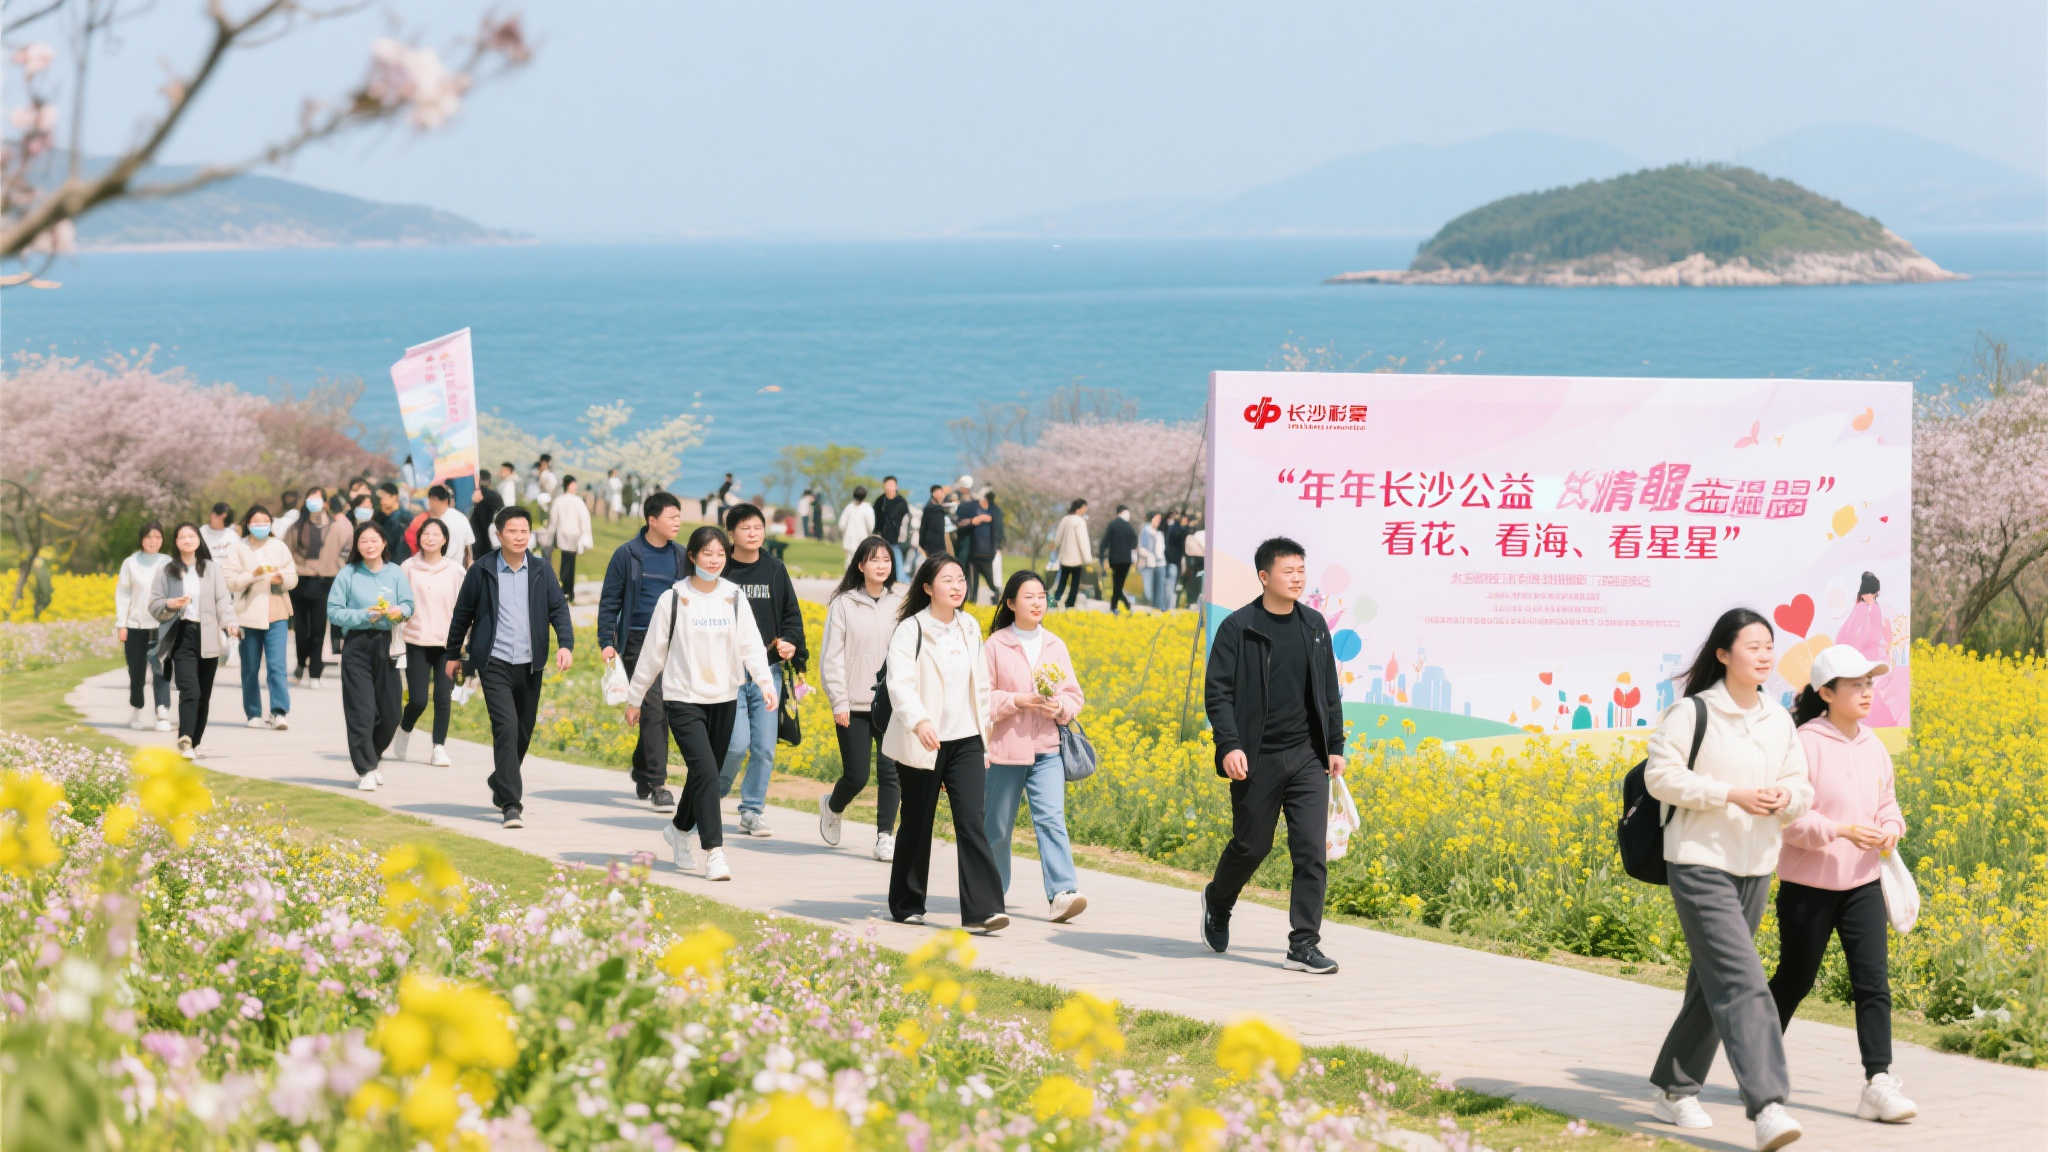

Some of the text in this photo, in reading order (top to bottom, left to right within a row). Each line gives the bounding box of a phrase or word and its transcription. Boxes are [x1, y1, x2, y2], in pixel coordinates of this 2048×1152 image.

[1382, 520, 1741, 559] 看花、看海、看星星”
